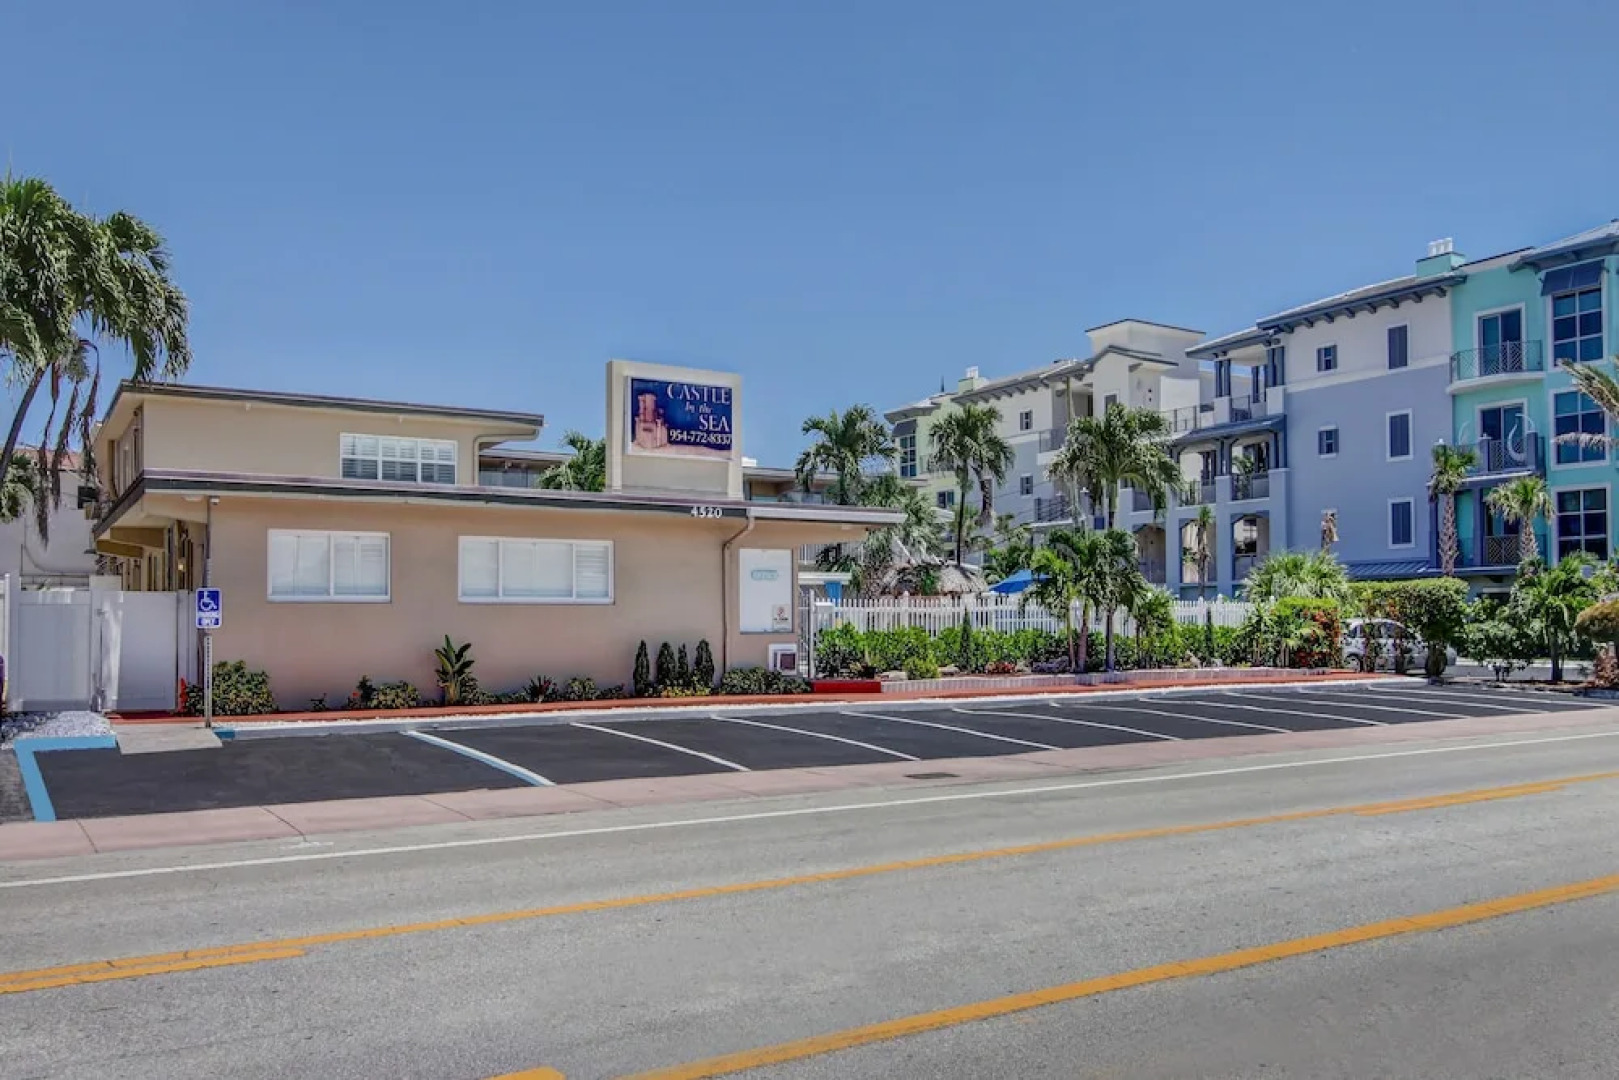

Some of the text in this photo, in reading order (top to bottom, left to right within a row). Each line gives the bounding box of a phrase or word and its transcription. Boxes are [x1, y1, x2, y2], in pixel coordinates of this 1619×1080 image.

[666, 383, 731, 404] CASTLE
[699, 402, 712, 414] the
[699, 414, 730, 432] SEA
[690, 506, 722, 518] 4520
